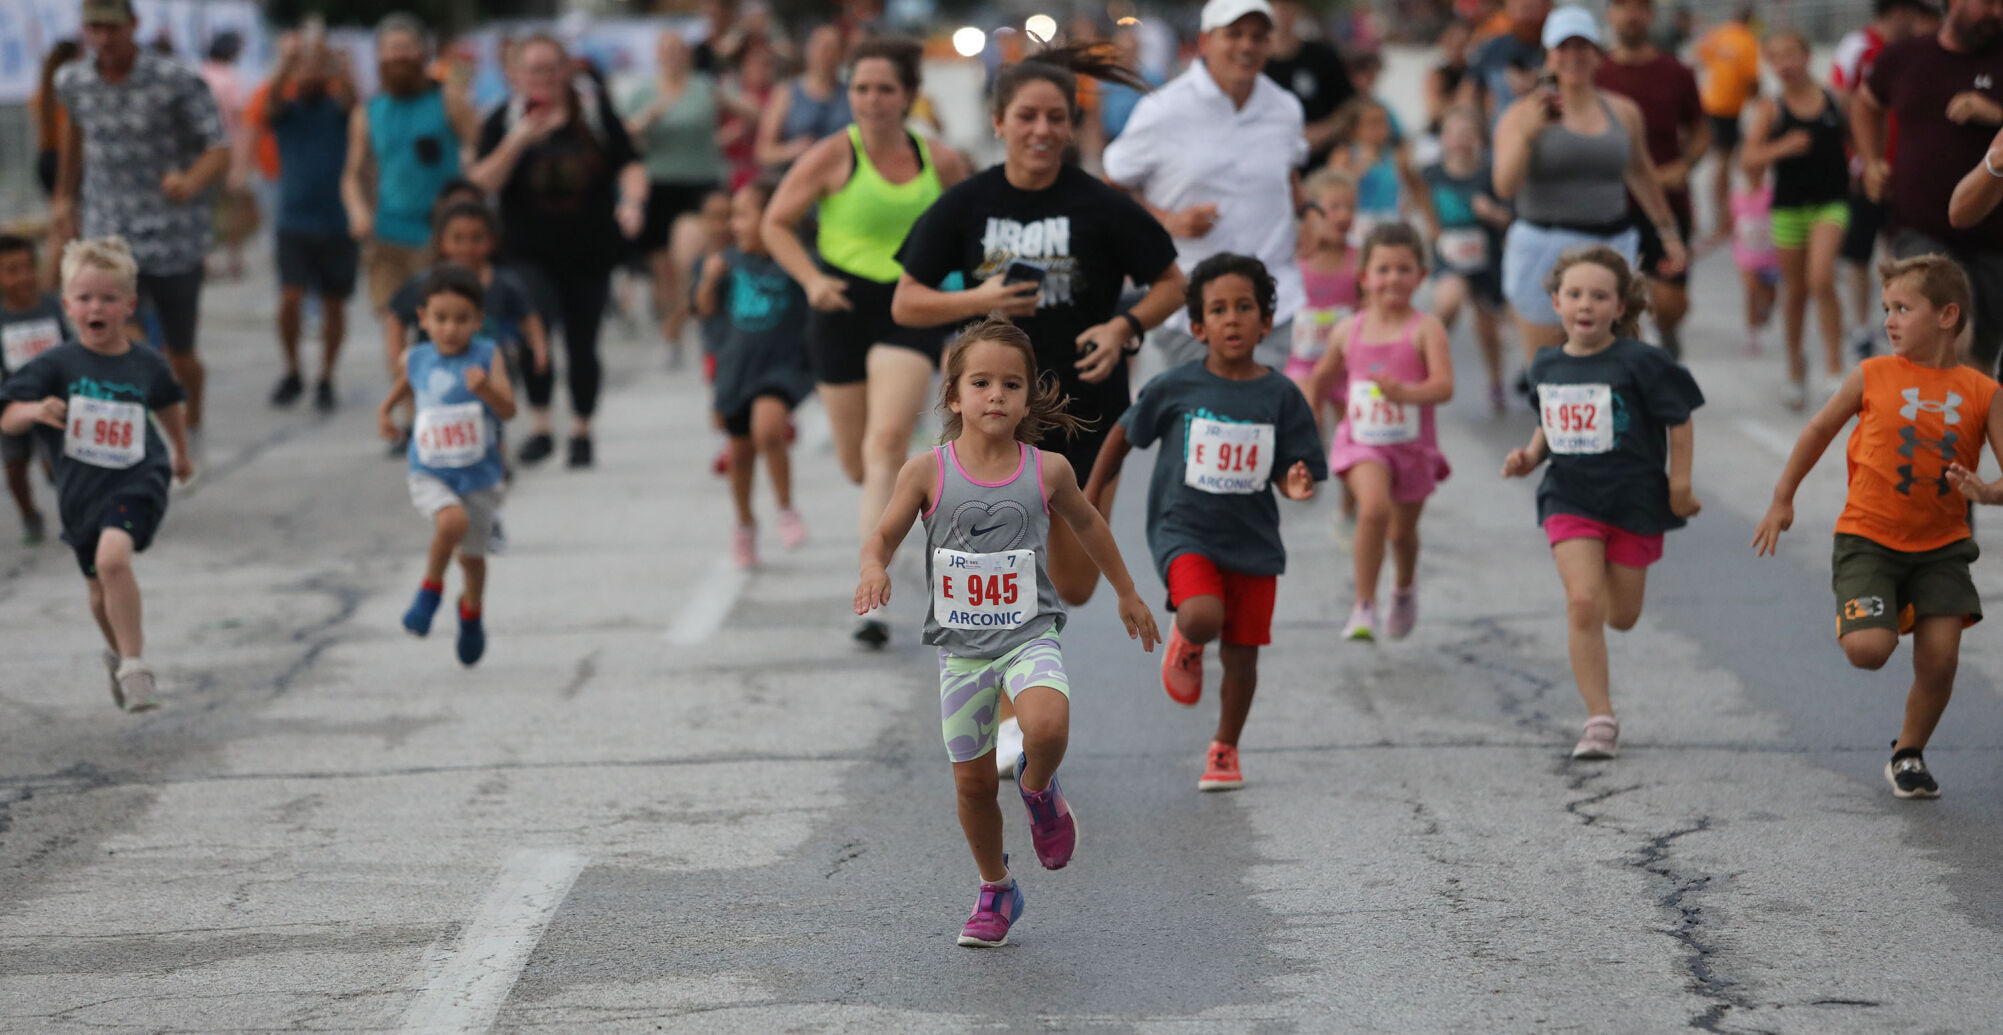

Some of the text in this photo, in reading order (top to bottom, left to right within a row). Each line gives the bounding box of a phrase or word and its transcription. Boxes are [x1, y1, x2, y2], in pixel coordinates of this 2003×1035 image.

[983, 216, 1070, 257] IRON
[1559, 404, 1596, 432] 952
[94, 419, 133, 448] 968
[1196, 443, 1258, 472] E 914
[1198, 475, 1257, 490] ARCONIC
[949, 555, 1016, 568] JR 7
[943, 573, 1018, 606] E 945
[948, 610, 1022, 626] ARCONIC
